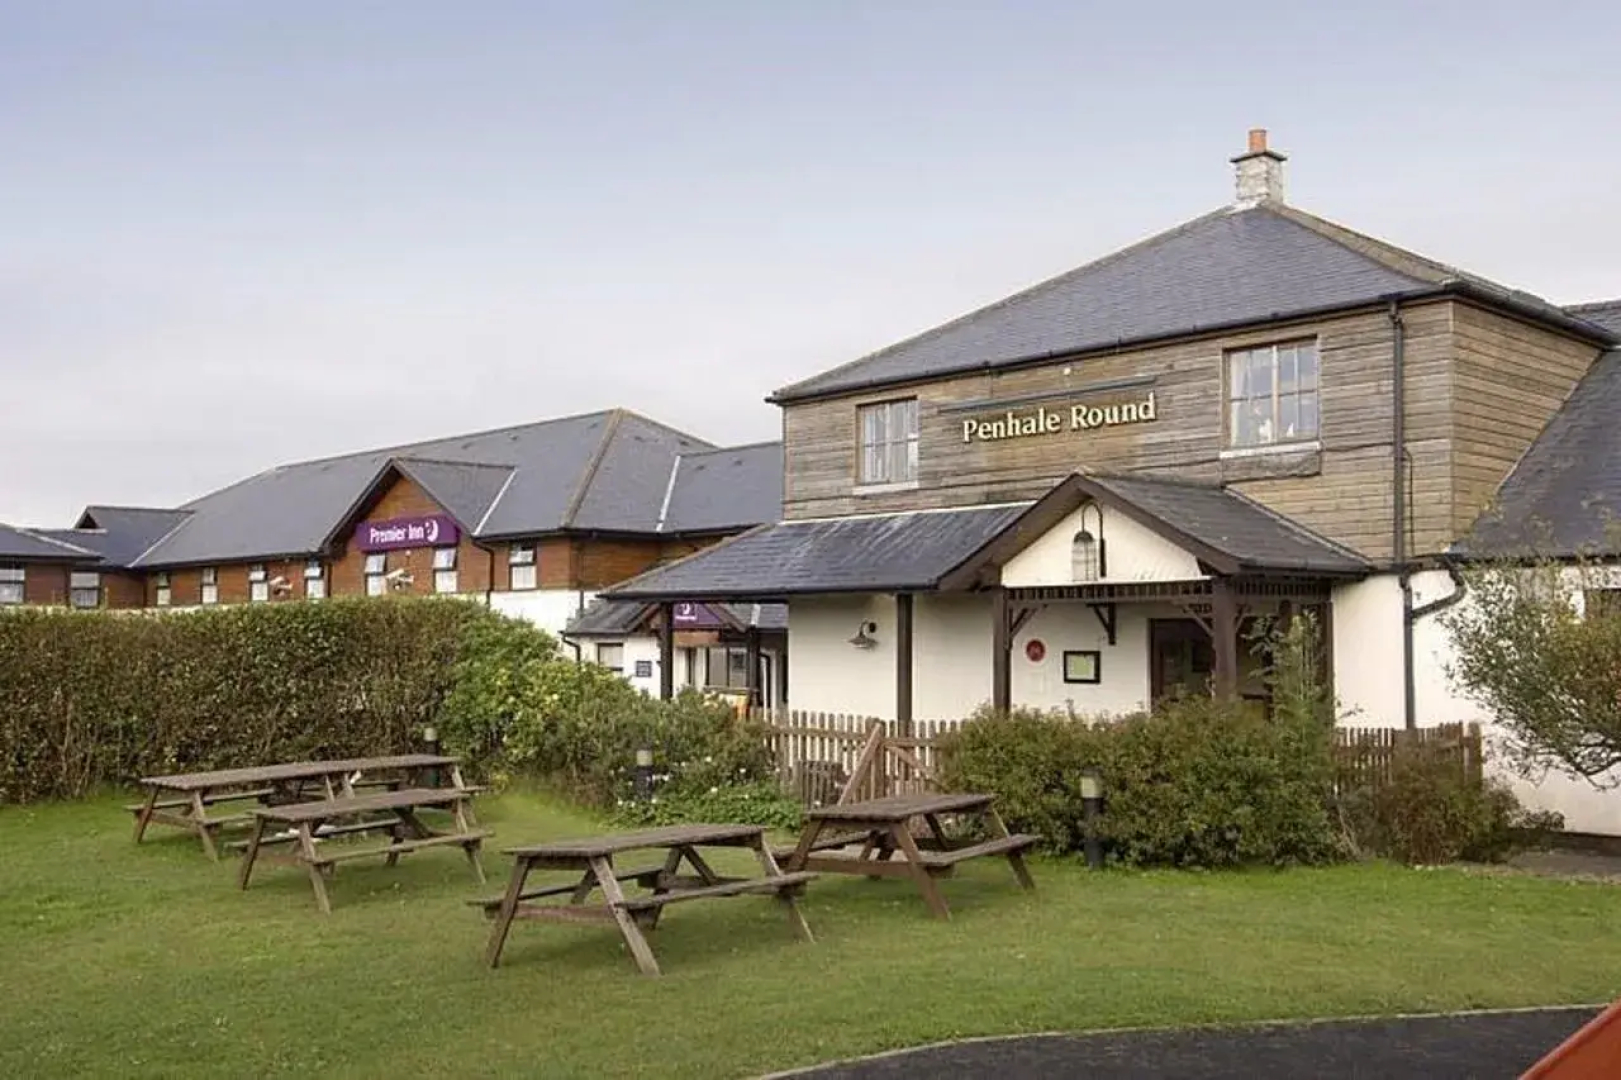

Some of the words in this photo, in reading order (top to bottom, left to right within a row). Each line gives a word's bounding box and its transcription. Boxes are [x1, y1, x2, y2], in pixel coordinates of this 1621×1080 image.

[963, 407, 1061, 442] Penhale
[1070, 392, 1156, 430] Round
[370, 525, 406, 543] Premier
[408, 523, 424, 540] Inn
